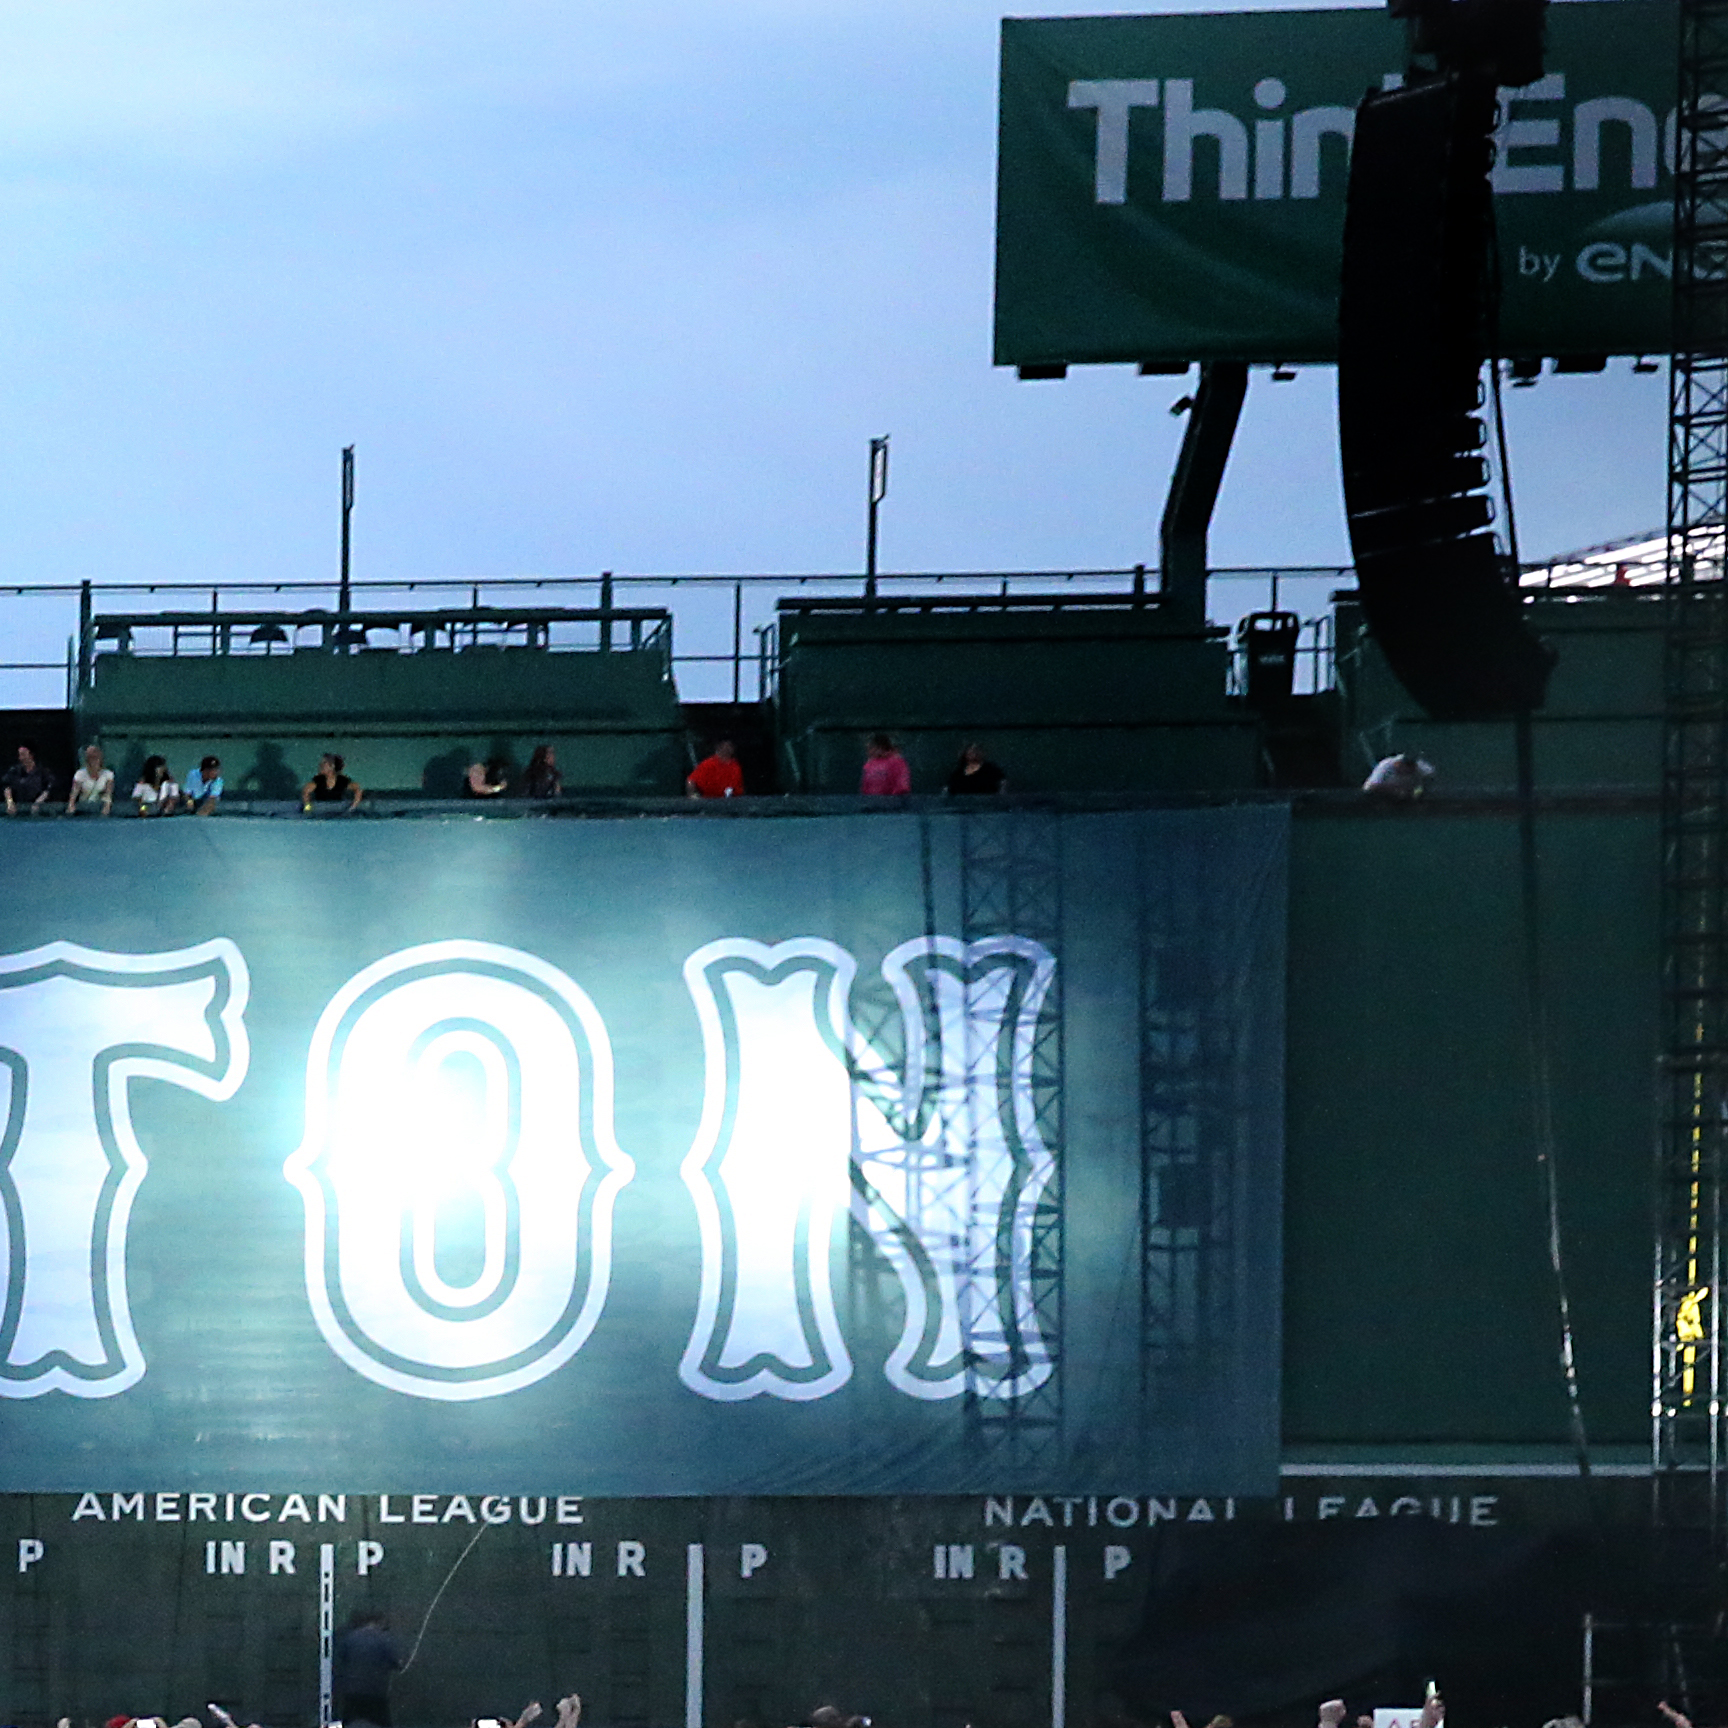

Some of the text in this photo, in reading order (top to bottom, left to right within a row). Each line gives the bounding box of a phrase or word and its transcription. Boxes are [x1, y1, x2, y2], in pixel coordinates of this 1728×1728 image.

[1067, 74, 1406, 204] Thin
[1518, 244, 1562, 283] by
[70, 1491, 586, 1526] AMERICAN LEAGUE
[19, 1538, 297, 1575] P IN R
[357, 1540, 647, 1578] P IN R
[740, 1543, 1029, 1581] P IN R
[1103, 1545, 1132, 1581] P
